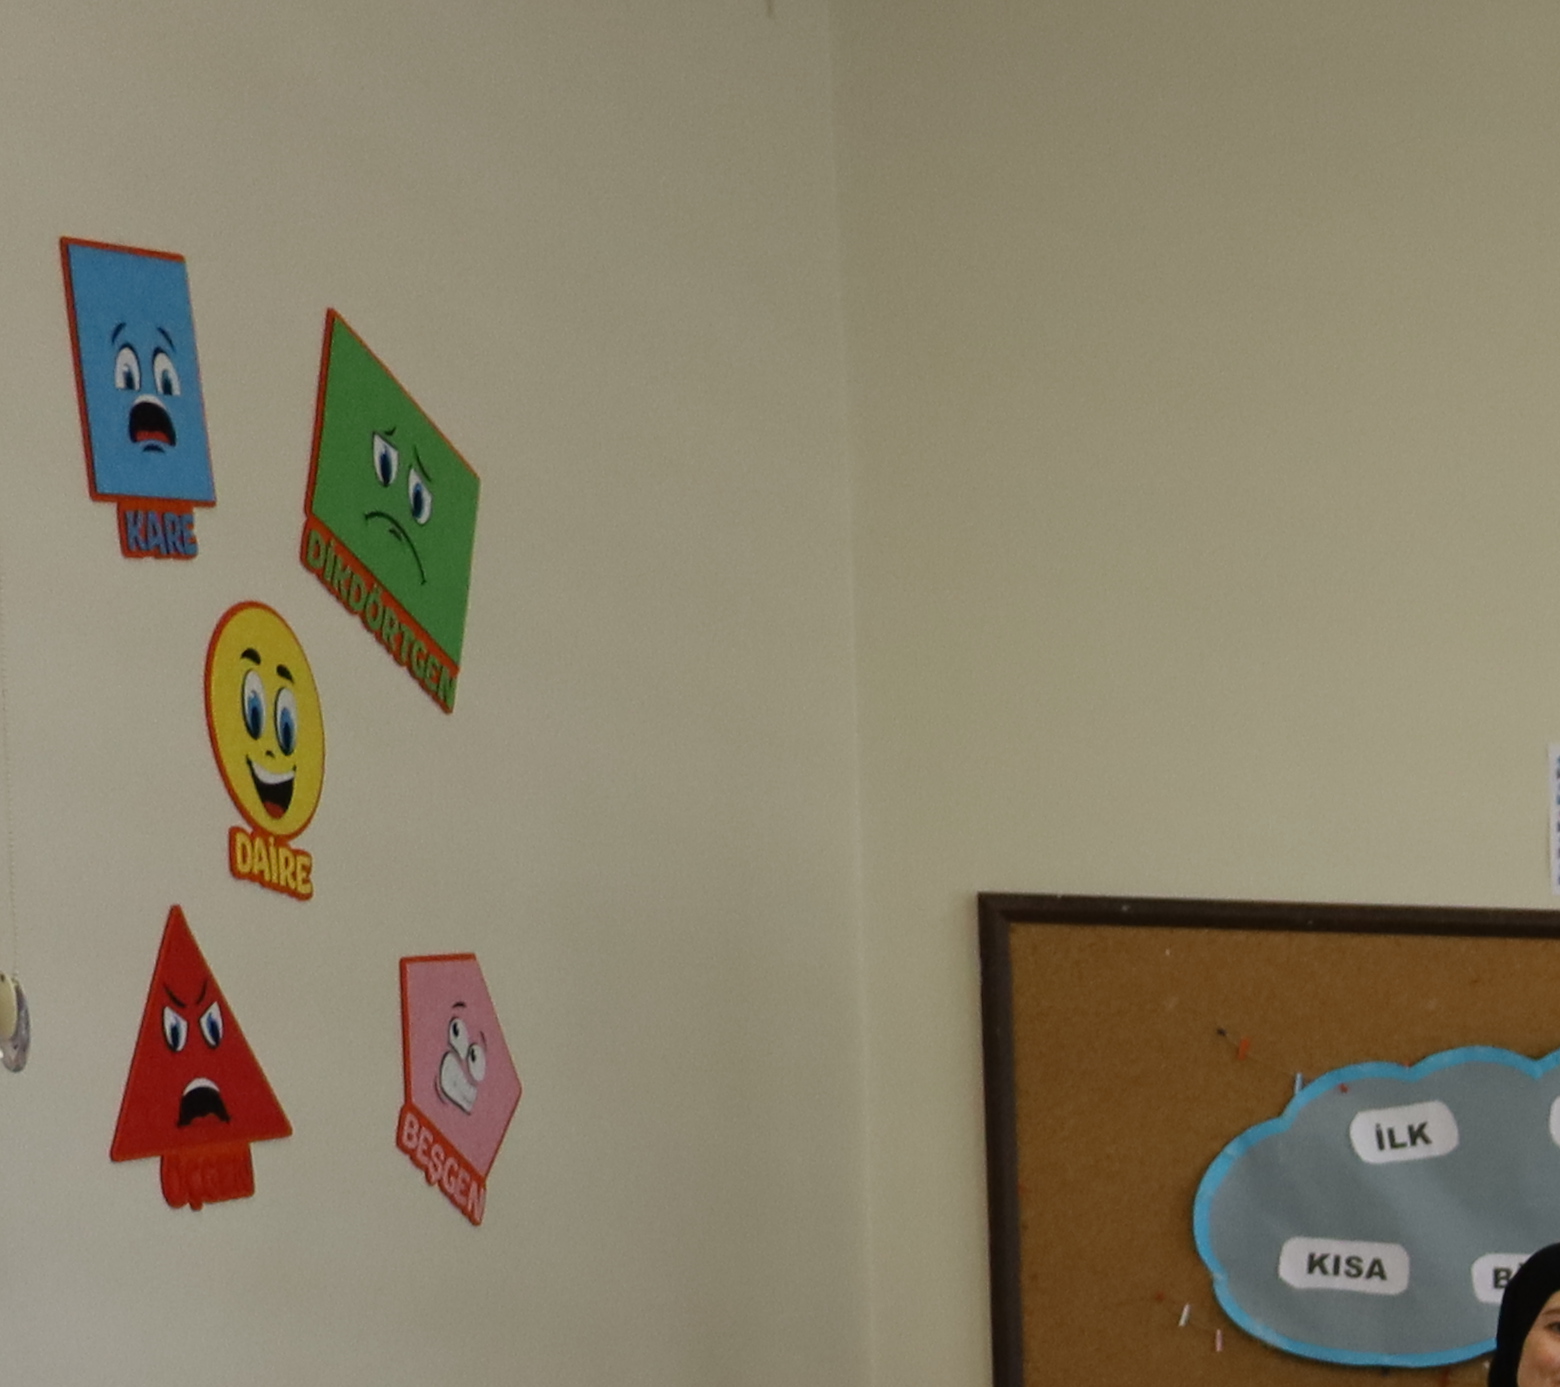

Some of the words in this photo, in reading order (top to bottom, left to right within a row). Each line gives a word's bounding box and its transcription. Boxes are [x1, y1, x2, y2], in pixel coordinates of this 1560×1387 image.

[125, 510, 199, 555] KARE
[306, 528, 457, 708] DİKDÖRTGEN
[235, 832, 313, 894] DAİRE
[1375, 1121, 1432, 1151] İLK
[402, 1112, 486, 1222] BEŞGEN
[1306, 1252, 1387, 1281] KISA
